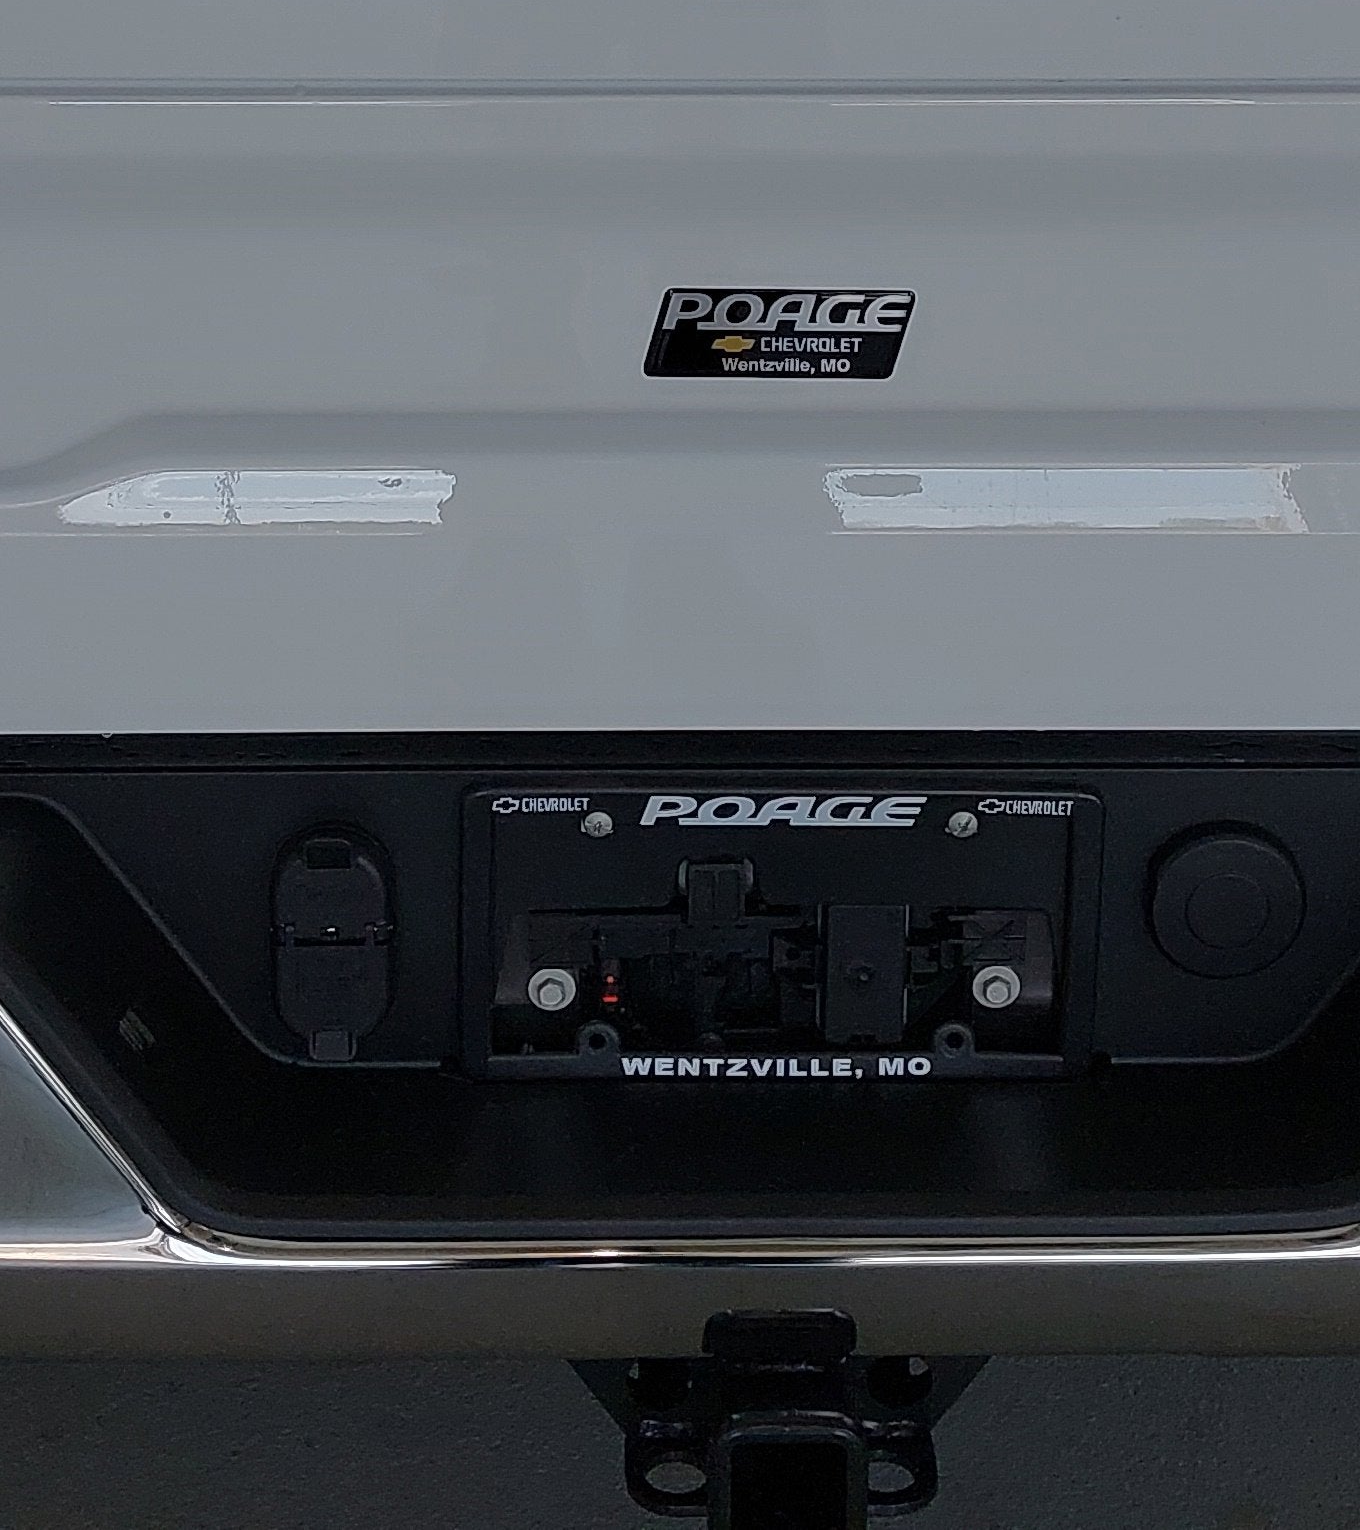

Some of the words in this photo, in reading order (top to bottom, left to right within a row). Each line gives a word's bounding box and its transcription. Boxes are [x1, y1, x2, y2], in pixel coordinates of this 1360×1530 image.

[662, 292, 912, 332] POAGE
[760, 336, 863, 353] CHEVROLET
[722, 357, 815, 375] Wentzville,
[821, 358, 851, 372] MO
[521, 797, 590, 812] CHEVROLET
[640, 796, 927, 826] POAGE
[1006, 800, 1074, 816] CHEVROLET
[621, 1057, 864, 1079] WENTZVILLE,
[878, 1057, 932, 1077] MO
